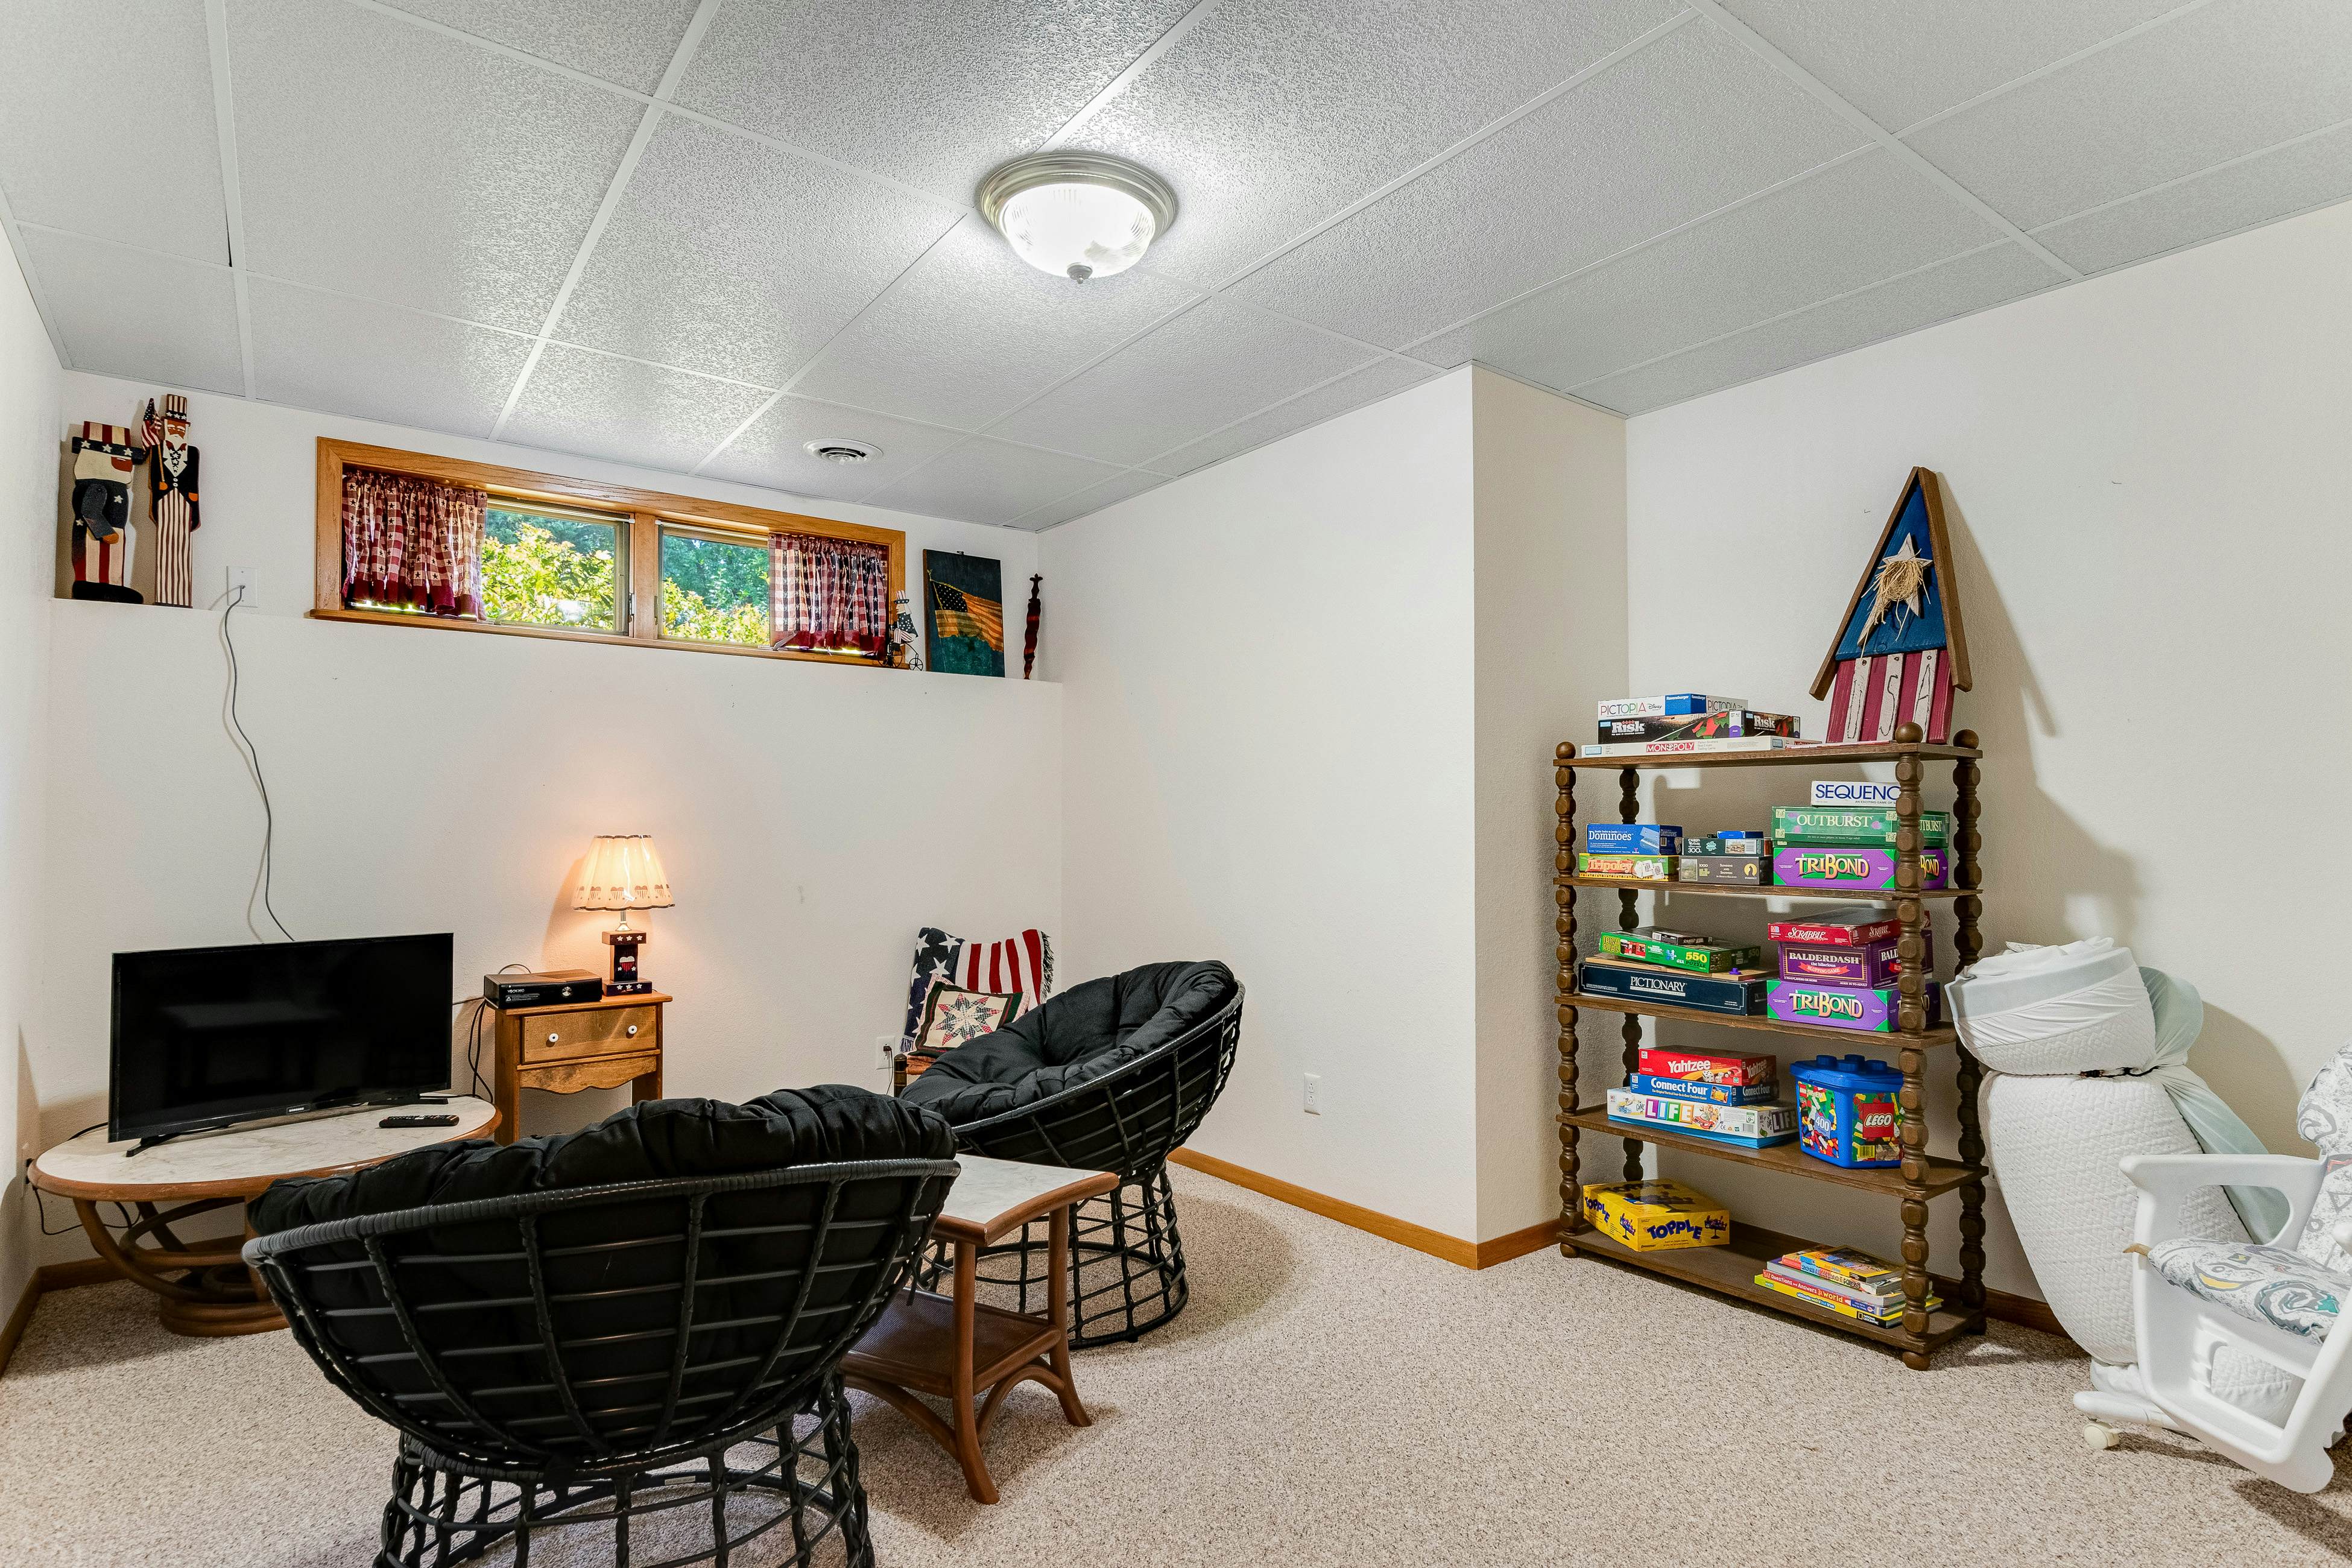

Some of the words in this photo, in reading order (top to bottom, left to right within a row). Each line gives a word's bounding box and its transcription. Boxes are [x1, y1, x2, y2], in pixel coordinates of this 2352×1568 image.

[1601, 702, 1646, 716] PICTOPIA
[1646, 742, 1695, 753] MONOPOLY
[1797, 814, 1873, 827] OUTBURST
[1589, 830, 1632, 841] Dominoes
[1588, 858, 1633, 873] Tripoley
[1603, 935, 1620, 946] IRISH
[1602, 944, 1620, 953] PUBS
[1685, 952, 1708, 963] 550
[1789, 952, 1859, 964] BALDERDASH
[1807, 966, 1827, 974] BLUFFING
[1630, 976, 1686, 992] PICTIONARY
[1667, 1059, 1712, 1074] Yahtzee
[1747, 1058, 1768, 1078] Yahtzee
[1650, 1077, 1686, 1093] Connect
[1687, 1083, 1709, 1096] Four
[1742, 1085, 1760, 1096] Connect
[1760, 1084, 1771, 1093] Four
[1648, 1100, 1693, 1122] LIFE
[1815, 1116, 1830, 1132] 400
[1865, 1114, 1892, 1127] LEGO
[1585, 1196, 1610, 1224] TOPPLE
[1646, 1219, 1703, 1240] TOPPLE
[1771, 1274, 1793, 1285] Questions
[1798, 1283, 1817, 1294] Answers
[1843, 1278, 1861, 1289] KIDS
